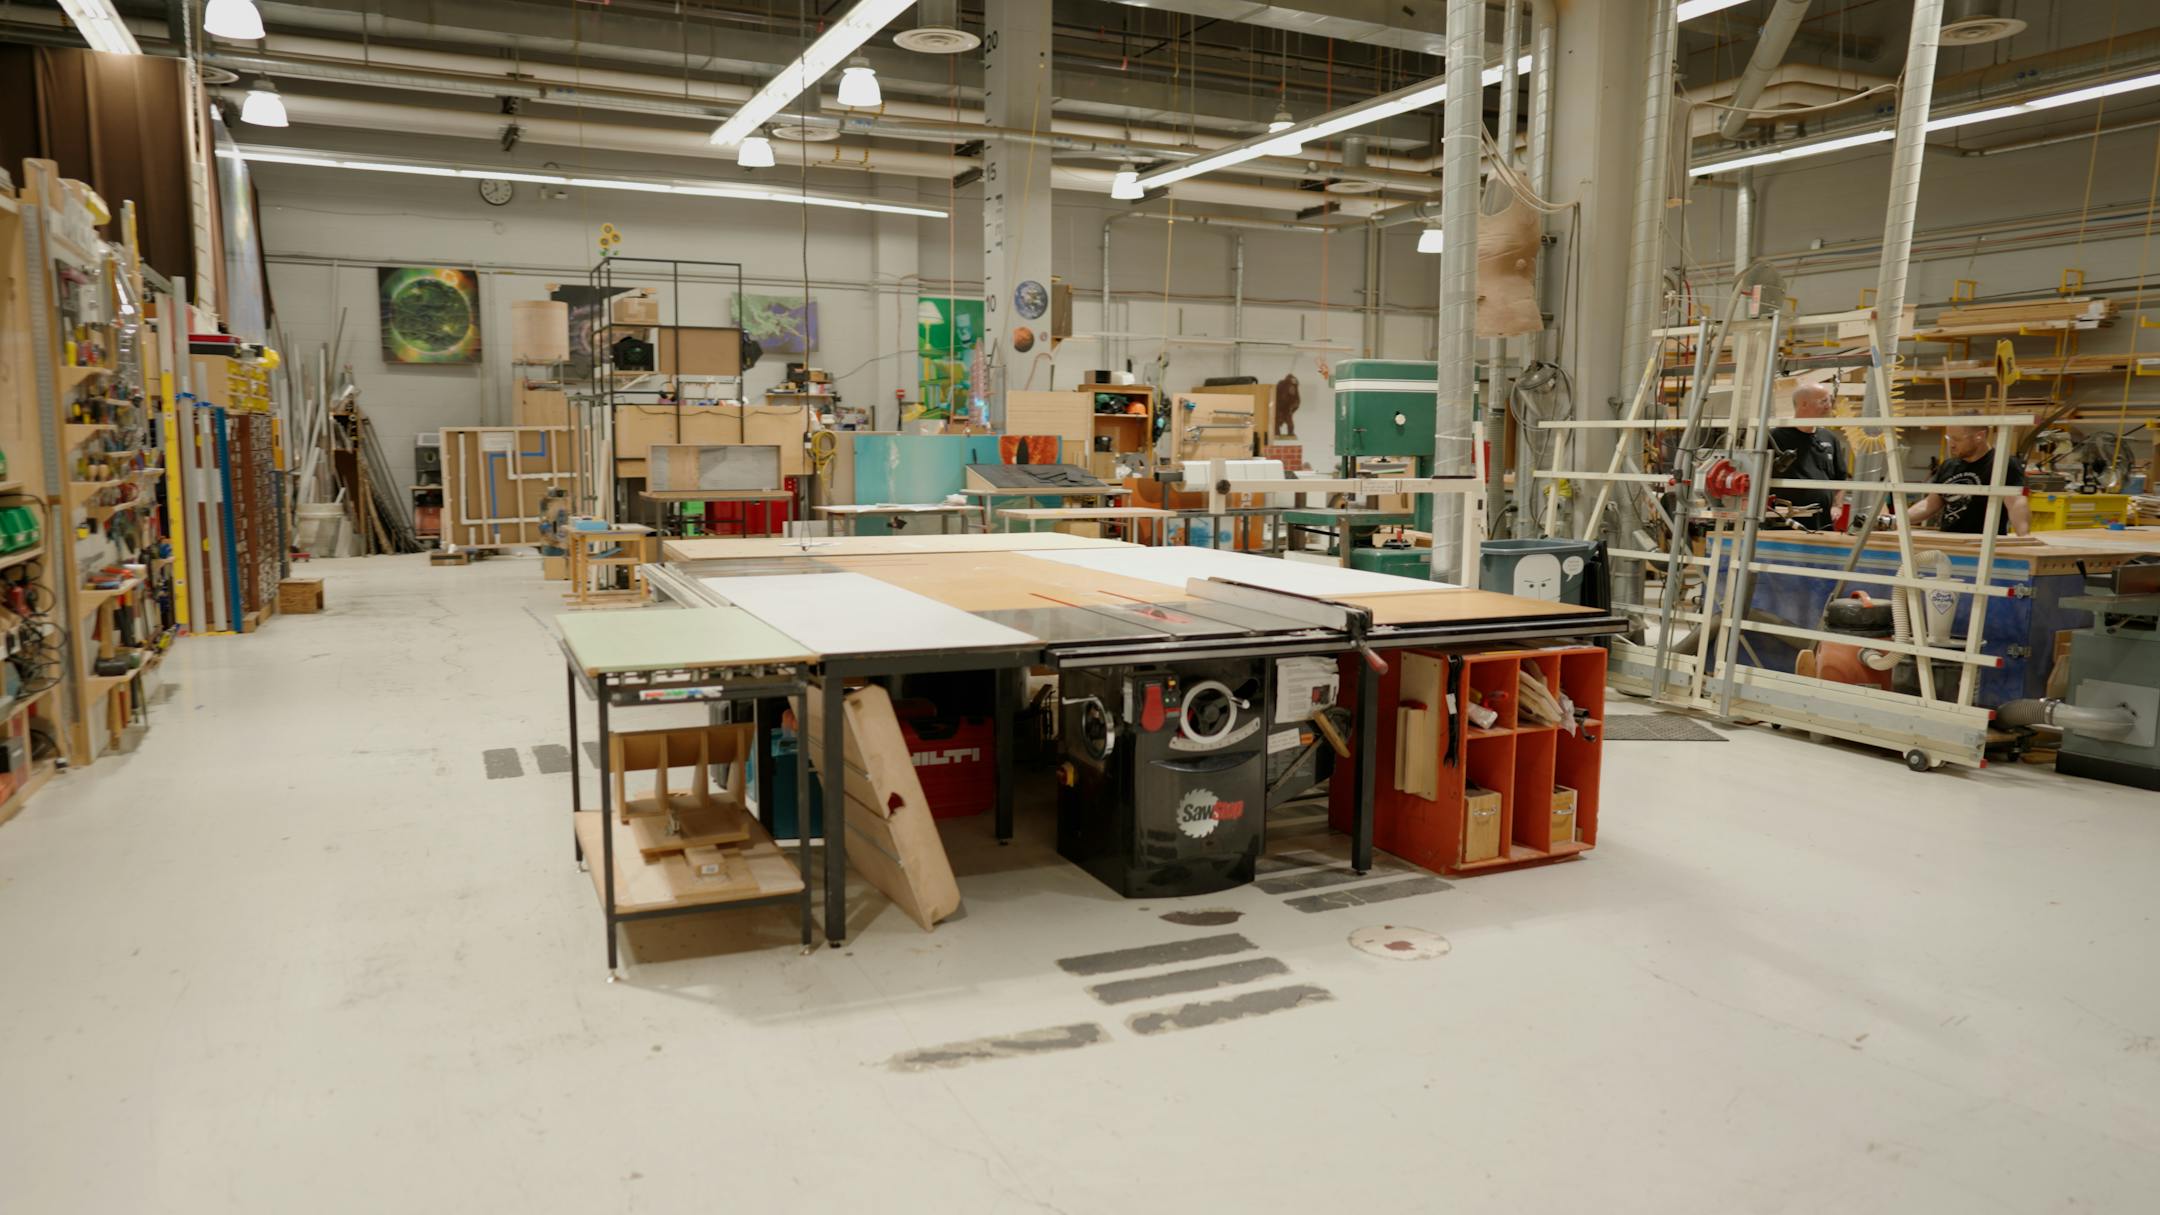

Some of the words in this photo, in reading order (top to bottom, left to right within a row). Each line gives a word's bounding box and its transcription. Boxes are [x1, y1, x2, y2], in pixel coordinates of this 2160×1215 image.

[986, 30, 998, 53] 20
[986, 162, 997, 183] 15
[986, 295, 997, 312] 10
